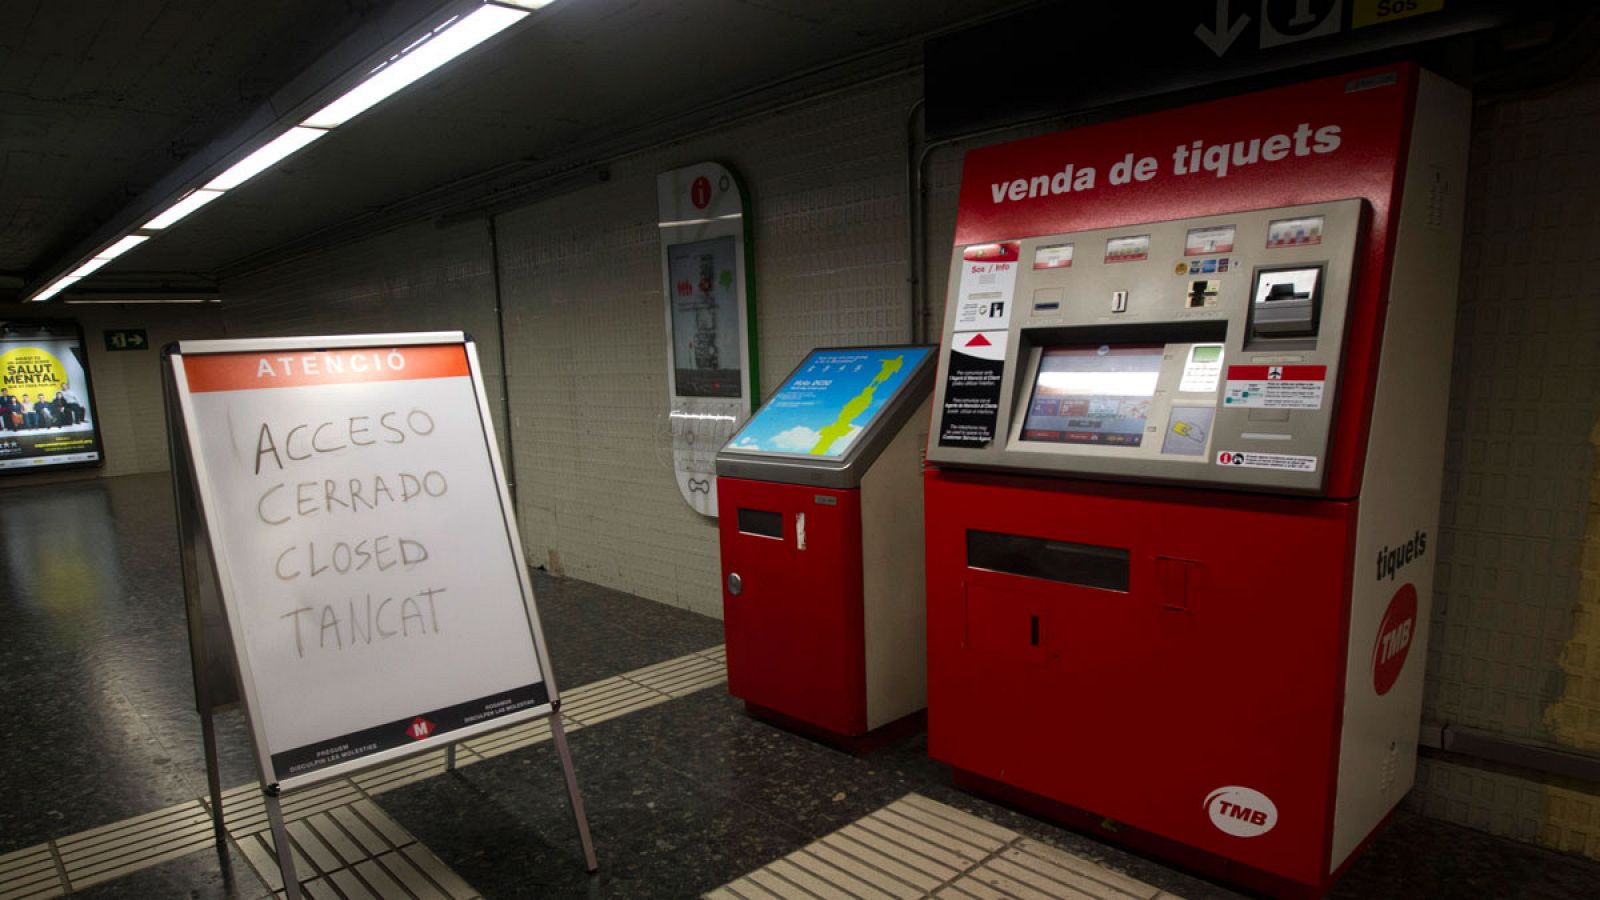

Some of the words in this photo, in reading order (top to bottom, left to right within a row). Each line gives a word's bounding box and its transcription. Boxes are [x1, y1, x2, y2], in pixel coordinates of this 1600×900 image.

[991, 164, 1096, 204] venda
[1109, 153, 1158, 186] de
[1172, 123, 1342, 178] tiquets
[3, 373, 60, 384] MENTAL
[7, 363, 52, 375] SALUT
[257, 348, 406, 378] ATENCIÓ
[254, 409, 435, 476] ACCESO
[257, 470, 448, 526] CERRADO
[275, 535, 429, 581] CLOSED
[1376, 529, 1427, 581] tiquets
[280, 587, 447, 659] TANCAT
[1380, 617, 1413, 665] TMB
[412, 721, 429, 737] M
[1220, 800, 1267, 827] TMB
